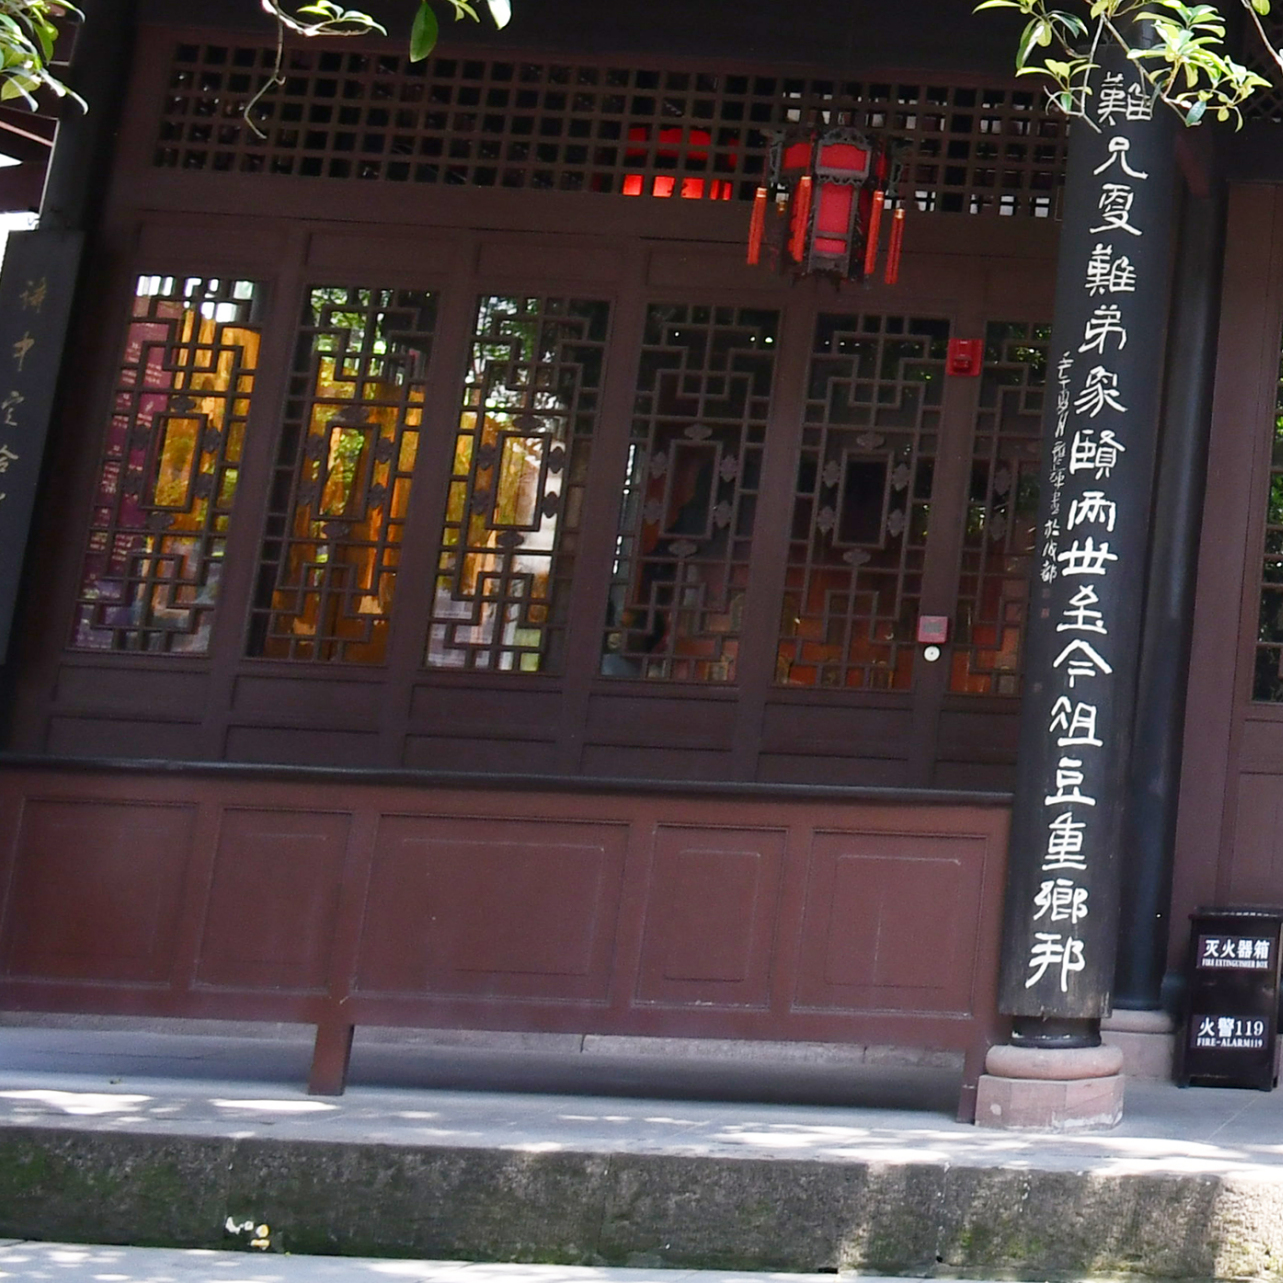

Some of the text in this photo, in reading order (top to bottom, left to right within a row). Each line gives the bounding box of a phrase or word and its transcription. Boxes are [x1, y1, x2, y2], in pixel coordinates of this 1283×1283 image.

[1203, 939, 1270, 959] 灭火器箱
[1198, 1017, 1264, 1038] 火警119
